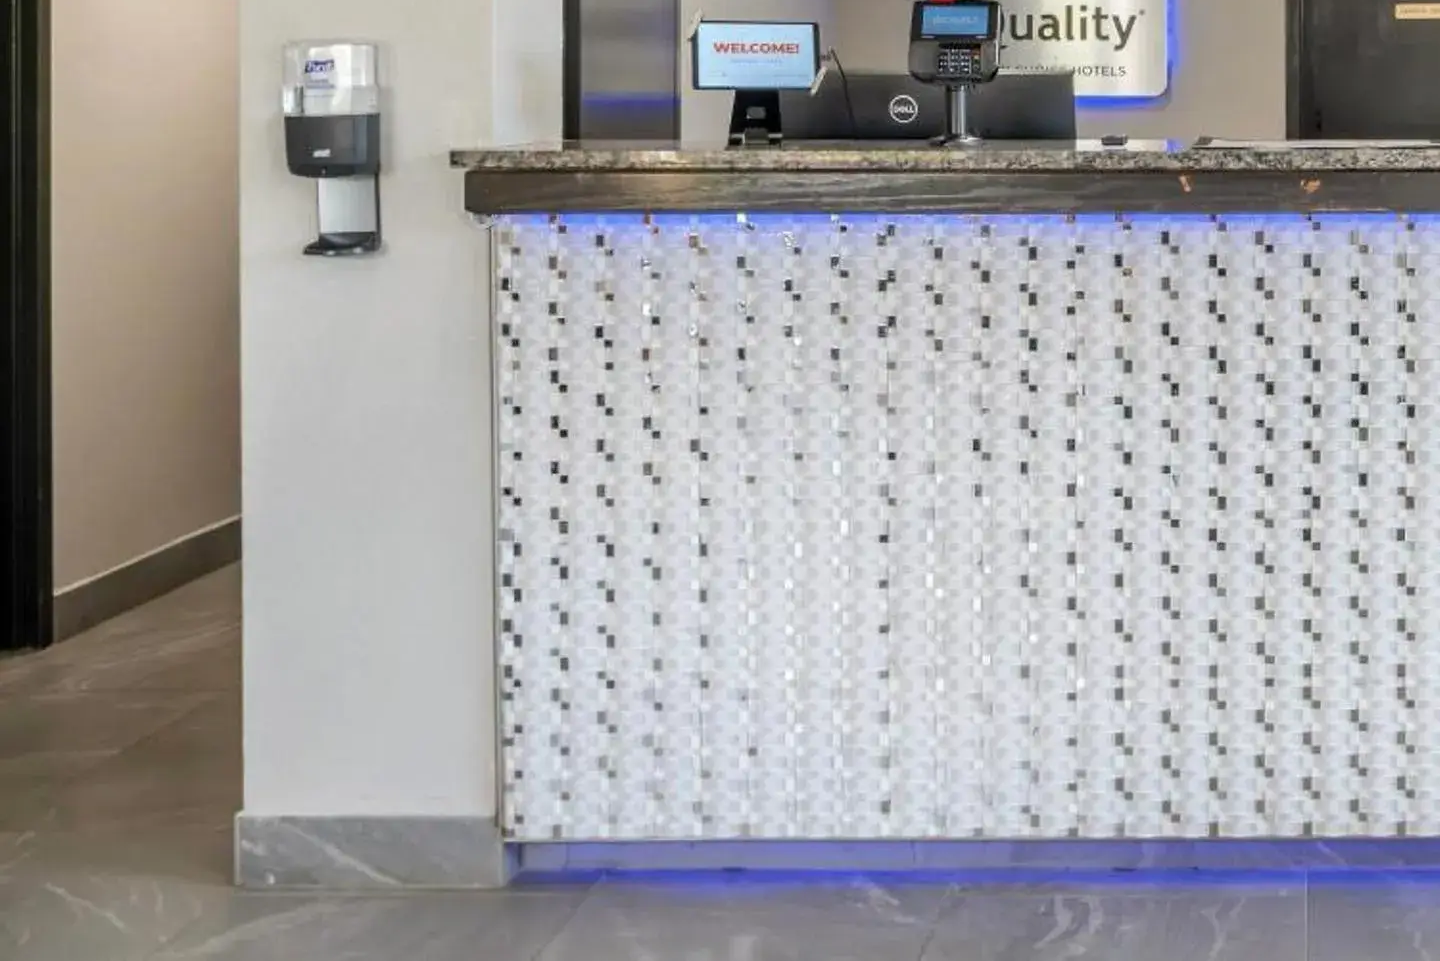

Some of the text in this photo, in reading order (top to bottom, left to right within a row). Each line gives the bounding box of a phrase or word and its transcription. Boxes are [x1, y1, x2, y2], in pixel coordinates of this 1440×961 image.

[999, 4, 1137, 51] uality
[713, 42, 800, 55] WELCOME!
[1072, 65, 1128, 77] HOTELS
